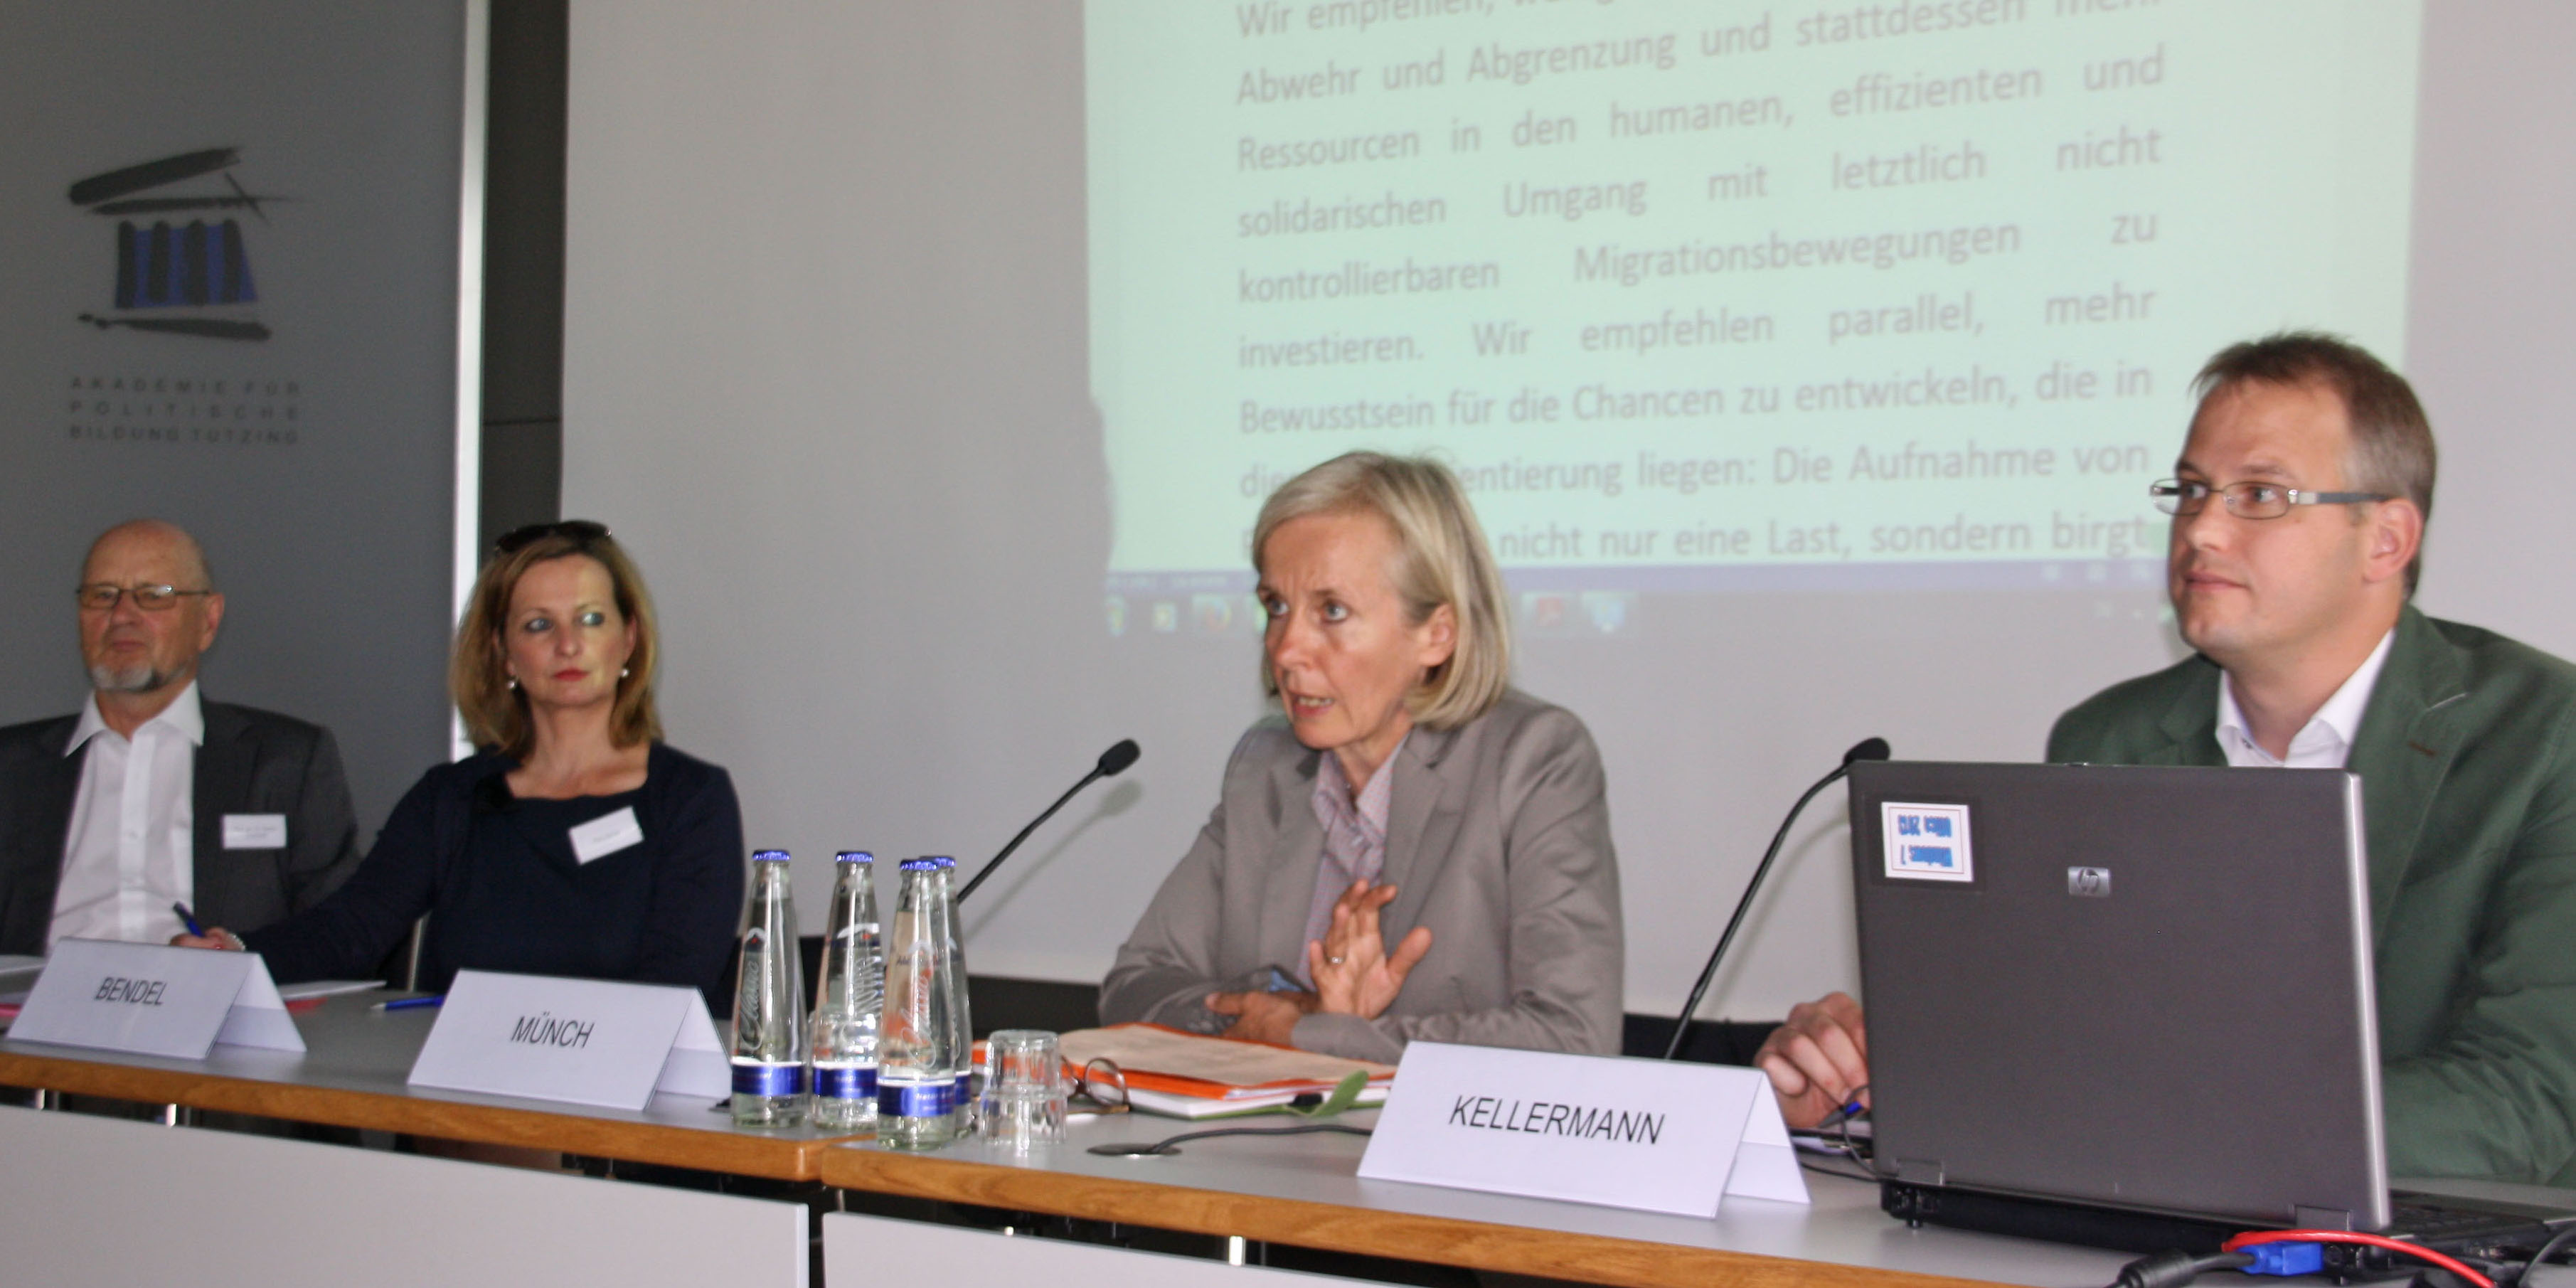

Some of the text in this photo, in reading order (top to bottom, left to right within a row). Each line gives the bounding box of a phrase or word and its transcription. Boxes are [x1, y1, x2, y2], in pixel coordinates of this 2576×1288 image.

[1237, 1, 1291, 37] Wir
[1236, 0, 2027, 105] Abwehr und Abgrenzung und stattdessen
[1237, 41, 2166, 171] Ressourcen in den humanen, effizienten und
[1237, 124, 2163, 239] solidarischen Umgang mit letztlich nicht
[1238, 213, 2159, 303] kontrollierbaren Migrationsbewegungen zu
[1238, 282, 2154, 368] investieren. Wir empfehlen parallel, mehr
[70, 376, 227, 395] AKADEMIE
[70, 400, 299, 421] POLITISCHE
[1239, 359, 2154, 435] Bewusstsein für die Chancen zu entwickeln, die in
[69, 425, 299, 445] BILDUNG TUTZING
[1637, 450, 1756, 496] liegen:
[1772, 445, 1833, 485] Die
[1848, 439, 2058, 481] Aufnahme
[2072, 444, 2150, 475] von
[1499, 512, 2150, 560] nicht nur eine Last, sondern birgt
[93, 976, 166, 1007] BENDEL
[509, 1011, 595, 1048] MÜNCH
[1449, 1095, 1665, 1145] KELLERMANN
